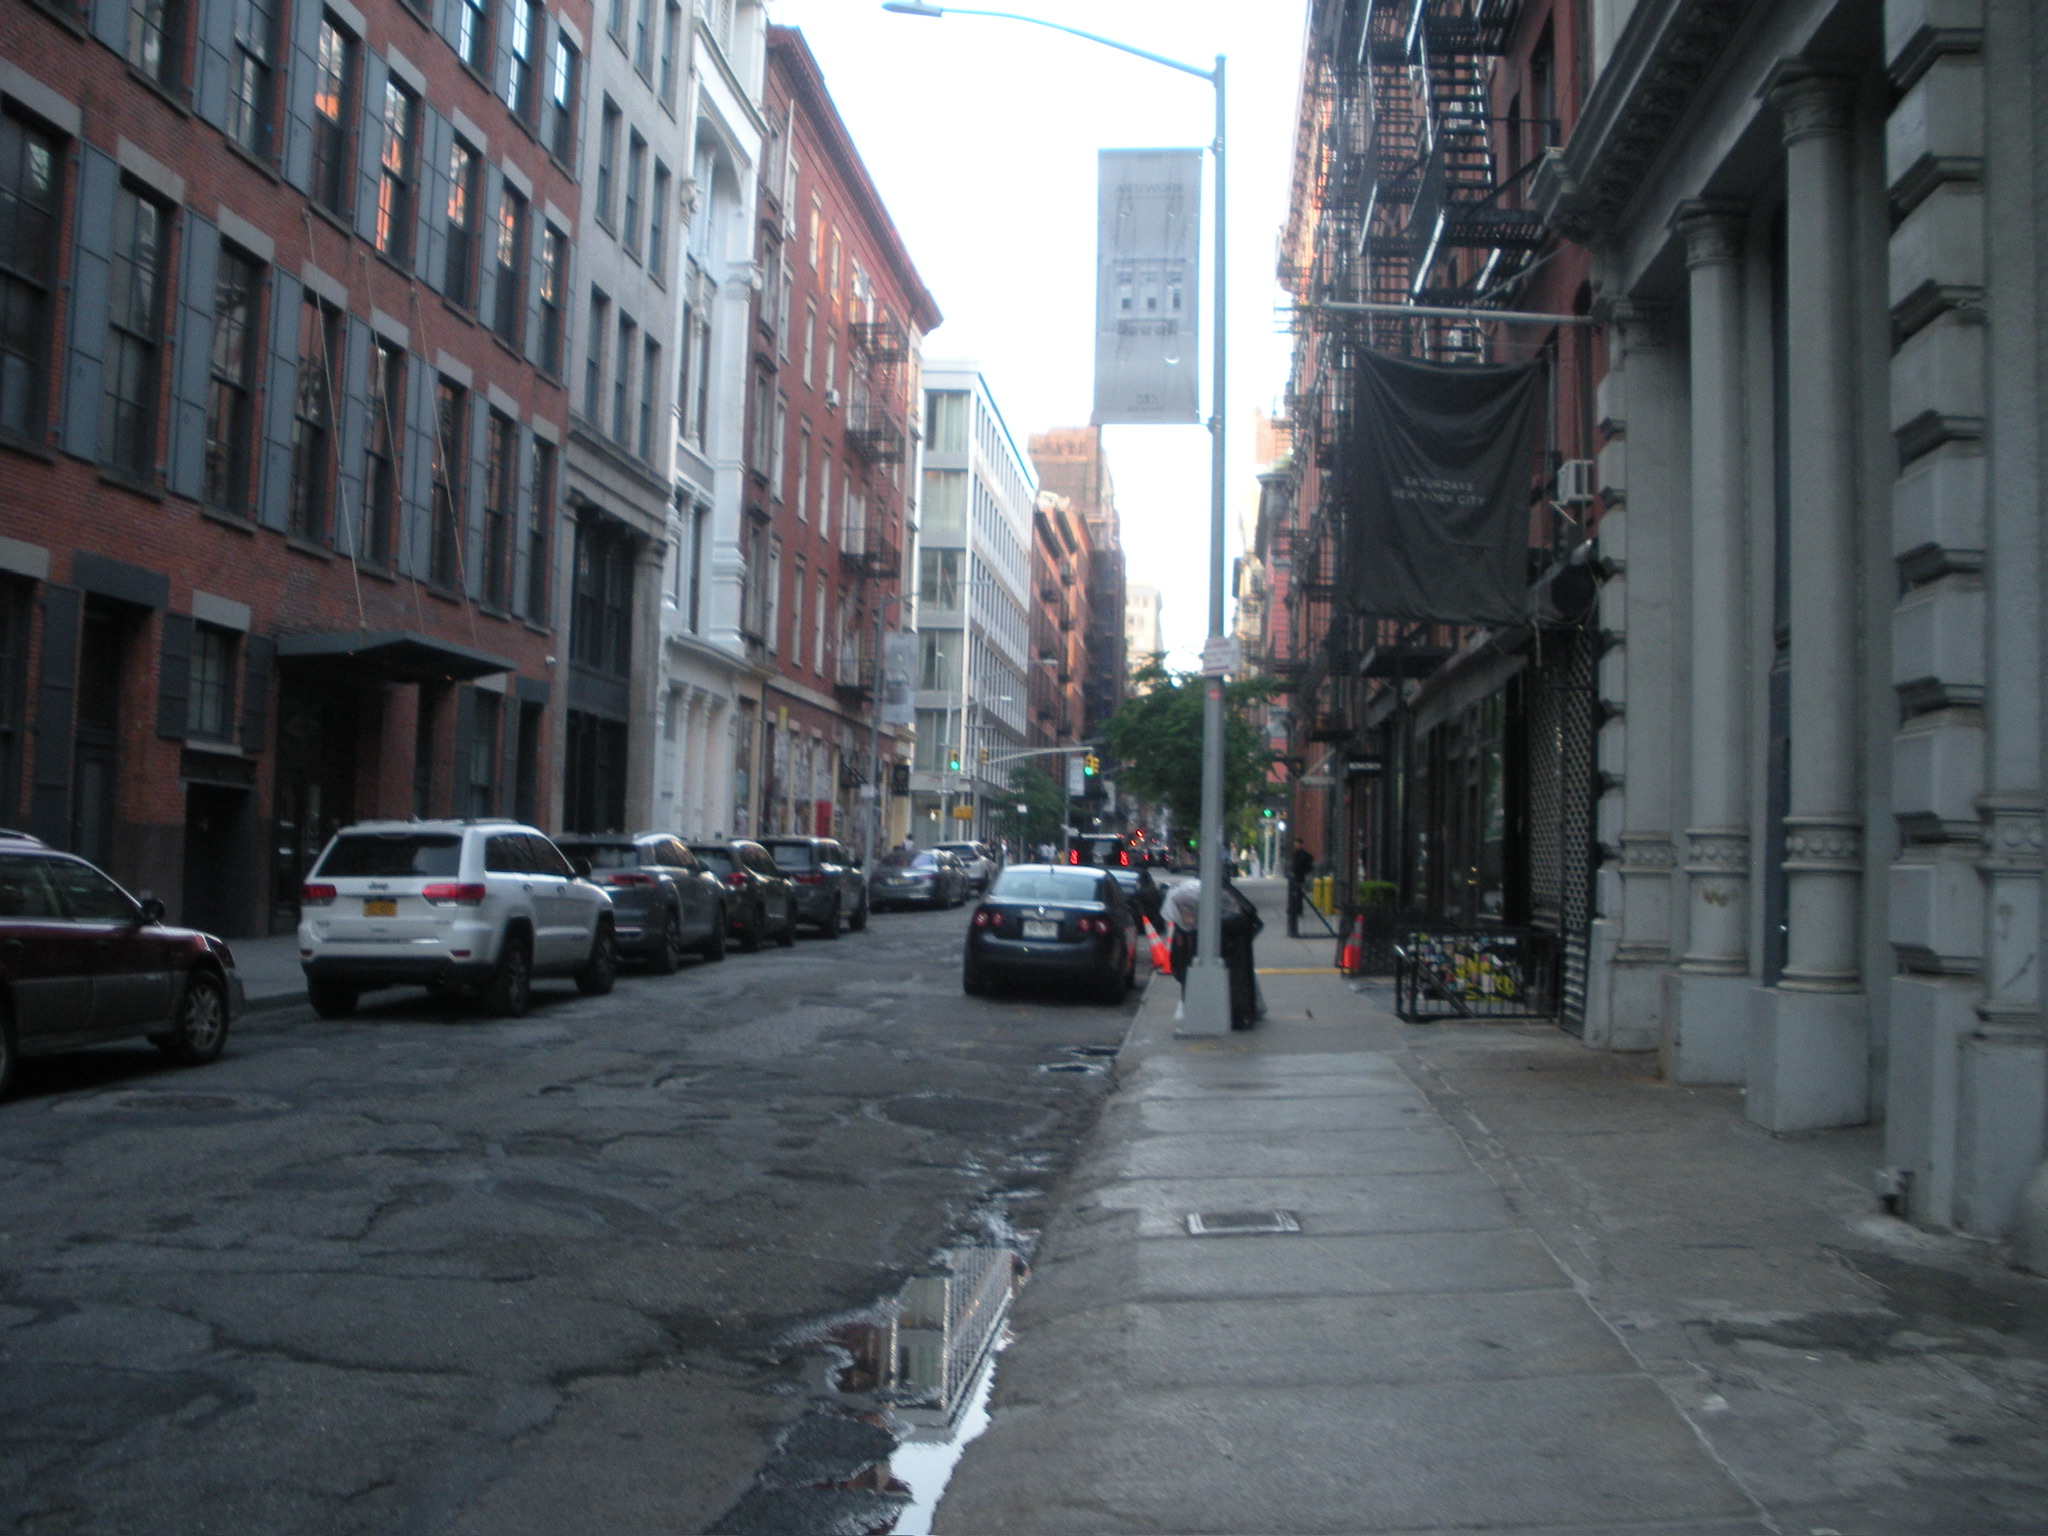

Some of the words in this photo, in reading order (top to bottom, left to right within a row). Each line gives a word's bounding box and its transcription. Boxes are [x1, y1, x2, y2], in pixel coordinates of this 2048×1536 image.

[1403, 476, 1473, 492] SATURDAYS
[1391, 488, 1417, 499] NEW
[1420, 491, 1453, 503] YORK
[1457, 495, 1486, 506] CITY
